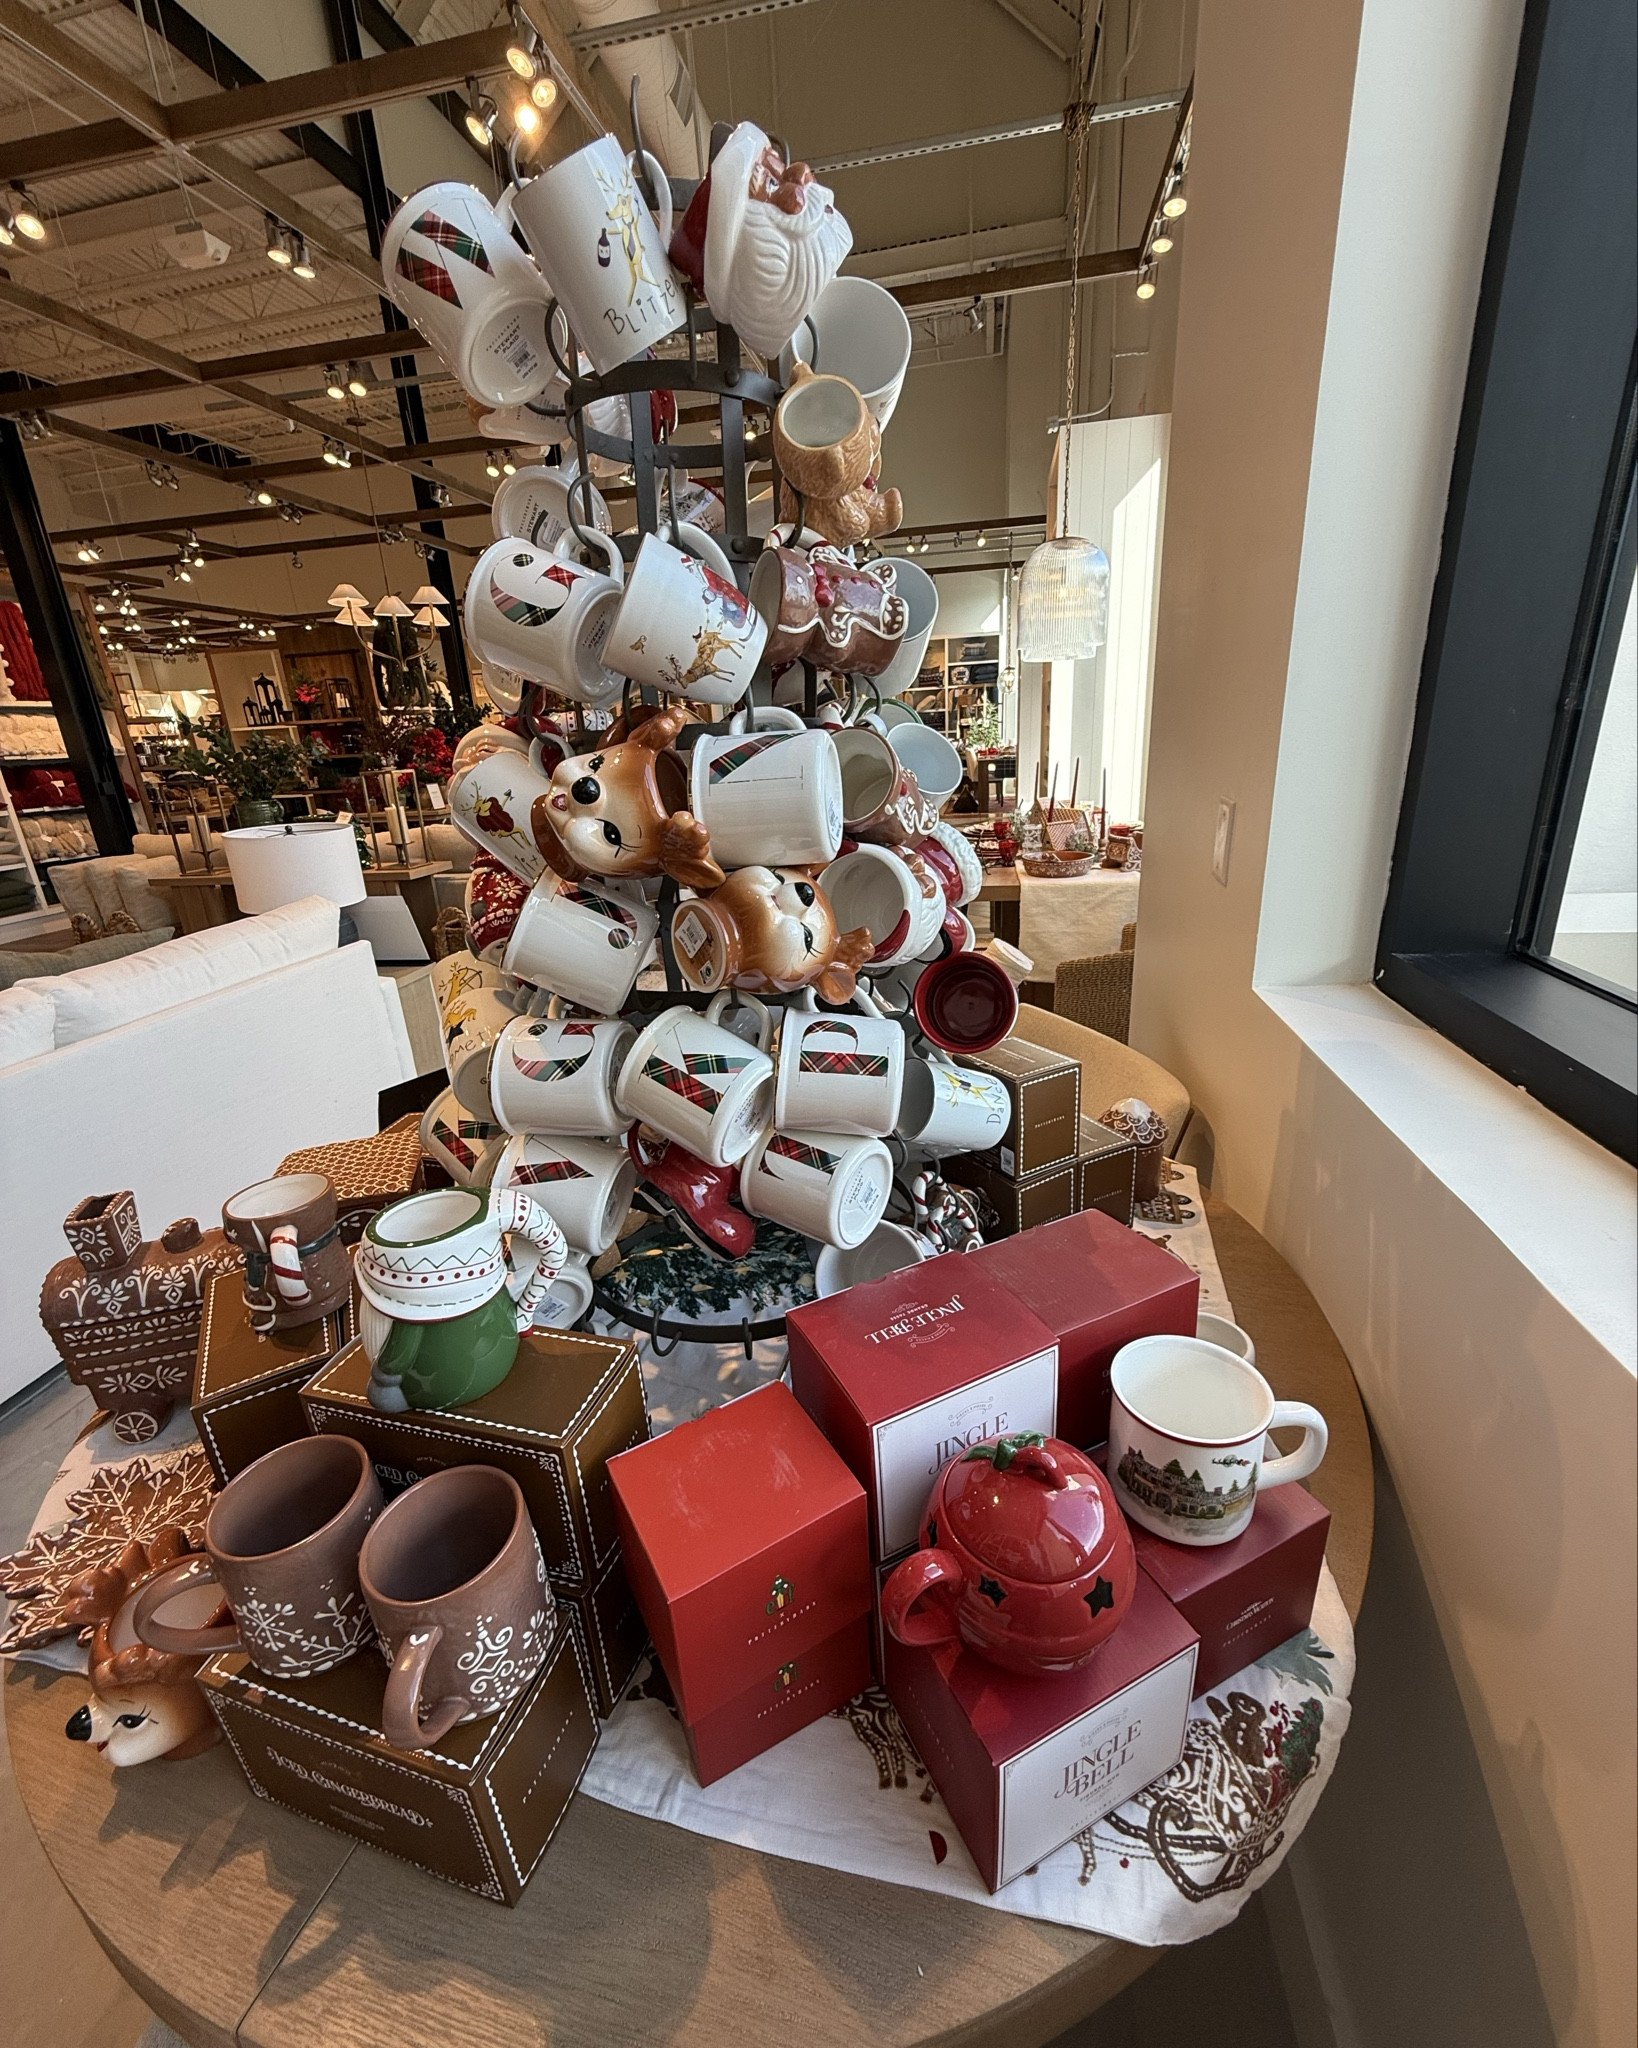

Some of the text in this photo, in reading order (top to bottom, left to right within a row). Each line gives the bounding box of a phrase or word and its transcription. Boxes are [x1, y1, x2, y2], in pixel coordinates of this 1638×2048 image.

[527, 502, 539, 537] STEWART
[638, 1022, 759, 1126] K
[799, 1021, 889, 1088] P
[864, 1318, 914, 1344] BELL
[911, 1294, 965, 1327] JINGLE
[928, 1412, 1009, 1475] JINGLE
[1054, 1719, 1141, 1799] JINGLE
[1067, 1747, 1134, 1798] BELL
[311, 1770, 426, 1827] GINGERBREAD
